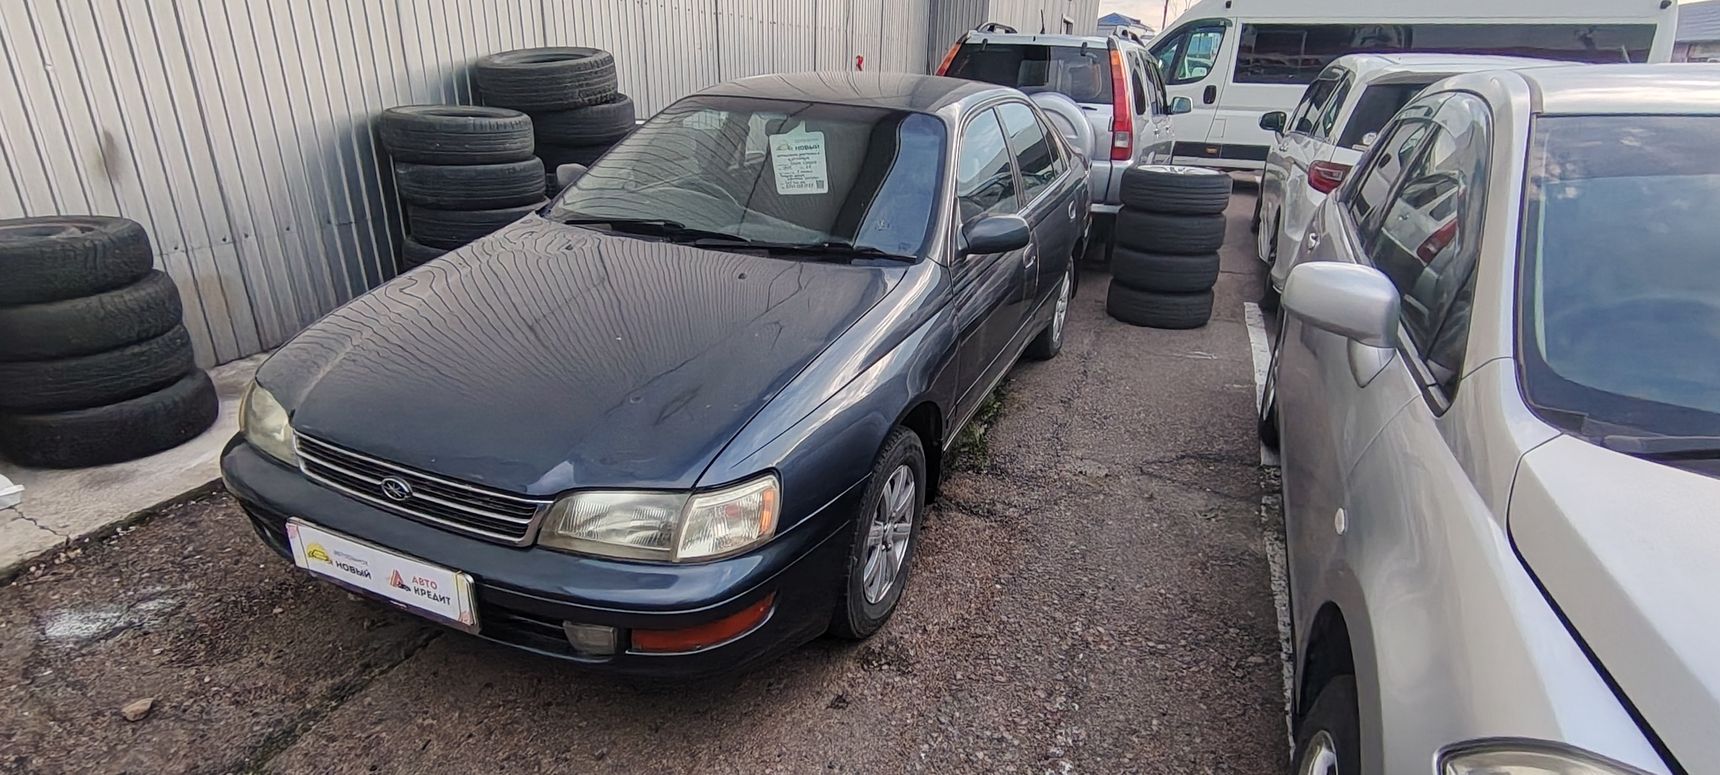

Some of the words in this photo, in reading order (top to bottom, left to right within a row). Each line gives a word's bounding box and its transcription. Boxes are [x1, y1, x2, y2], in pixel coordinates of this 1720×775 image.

[336, 561, 372, 580] НОВЫЙ
[411, 576, 438, 590] АВТО
[414, 586, 451, 605] КРЕДИТ
